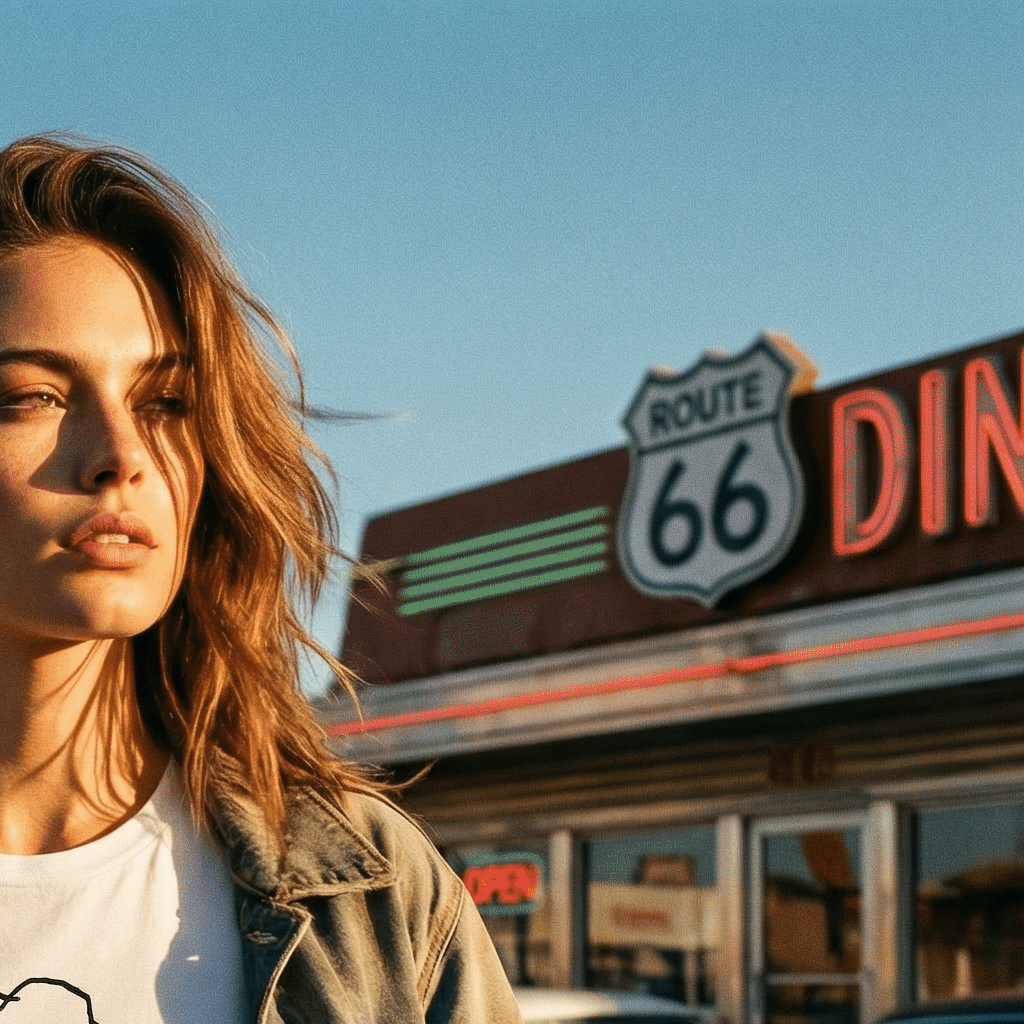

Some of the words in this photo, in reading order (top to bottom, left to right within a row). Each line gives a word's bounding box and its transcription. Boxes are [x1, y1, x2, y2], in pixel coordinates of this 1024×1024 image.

[649, 370, 763, 438] ROUTE
[831, 346, 1024, 556] DIN
[649, 439, 770, 567] 66
